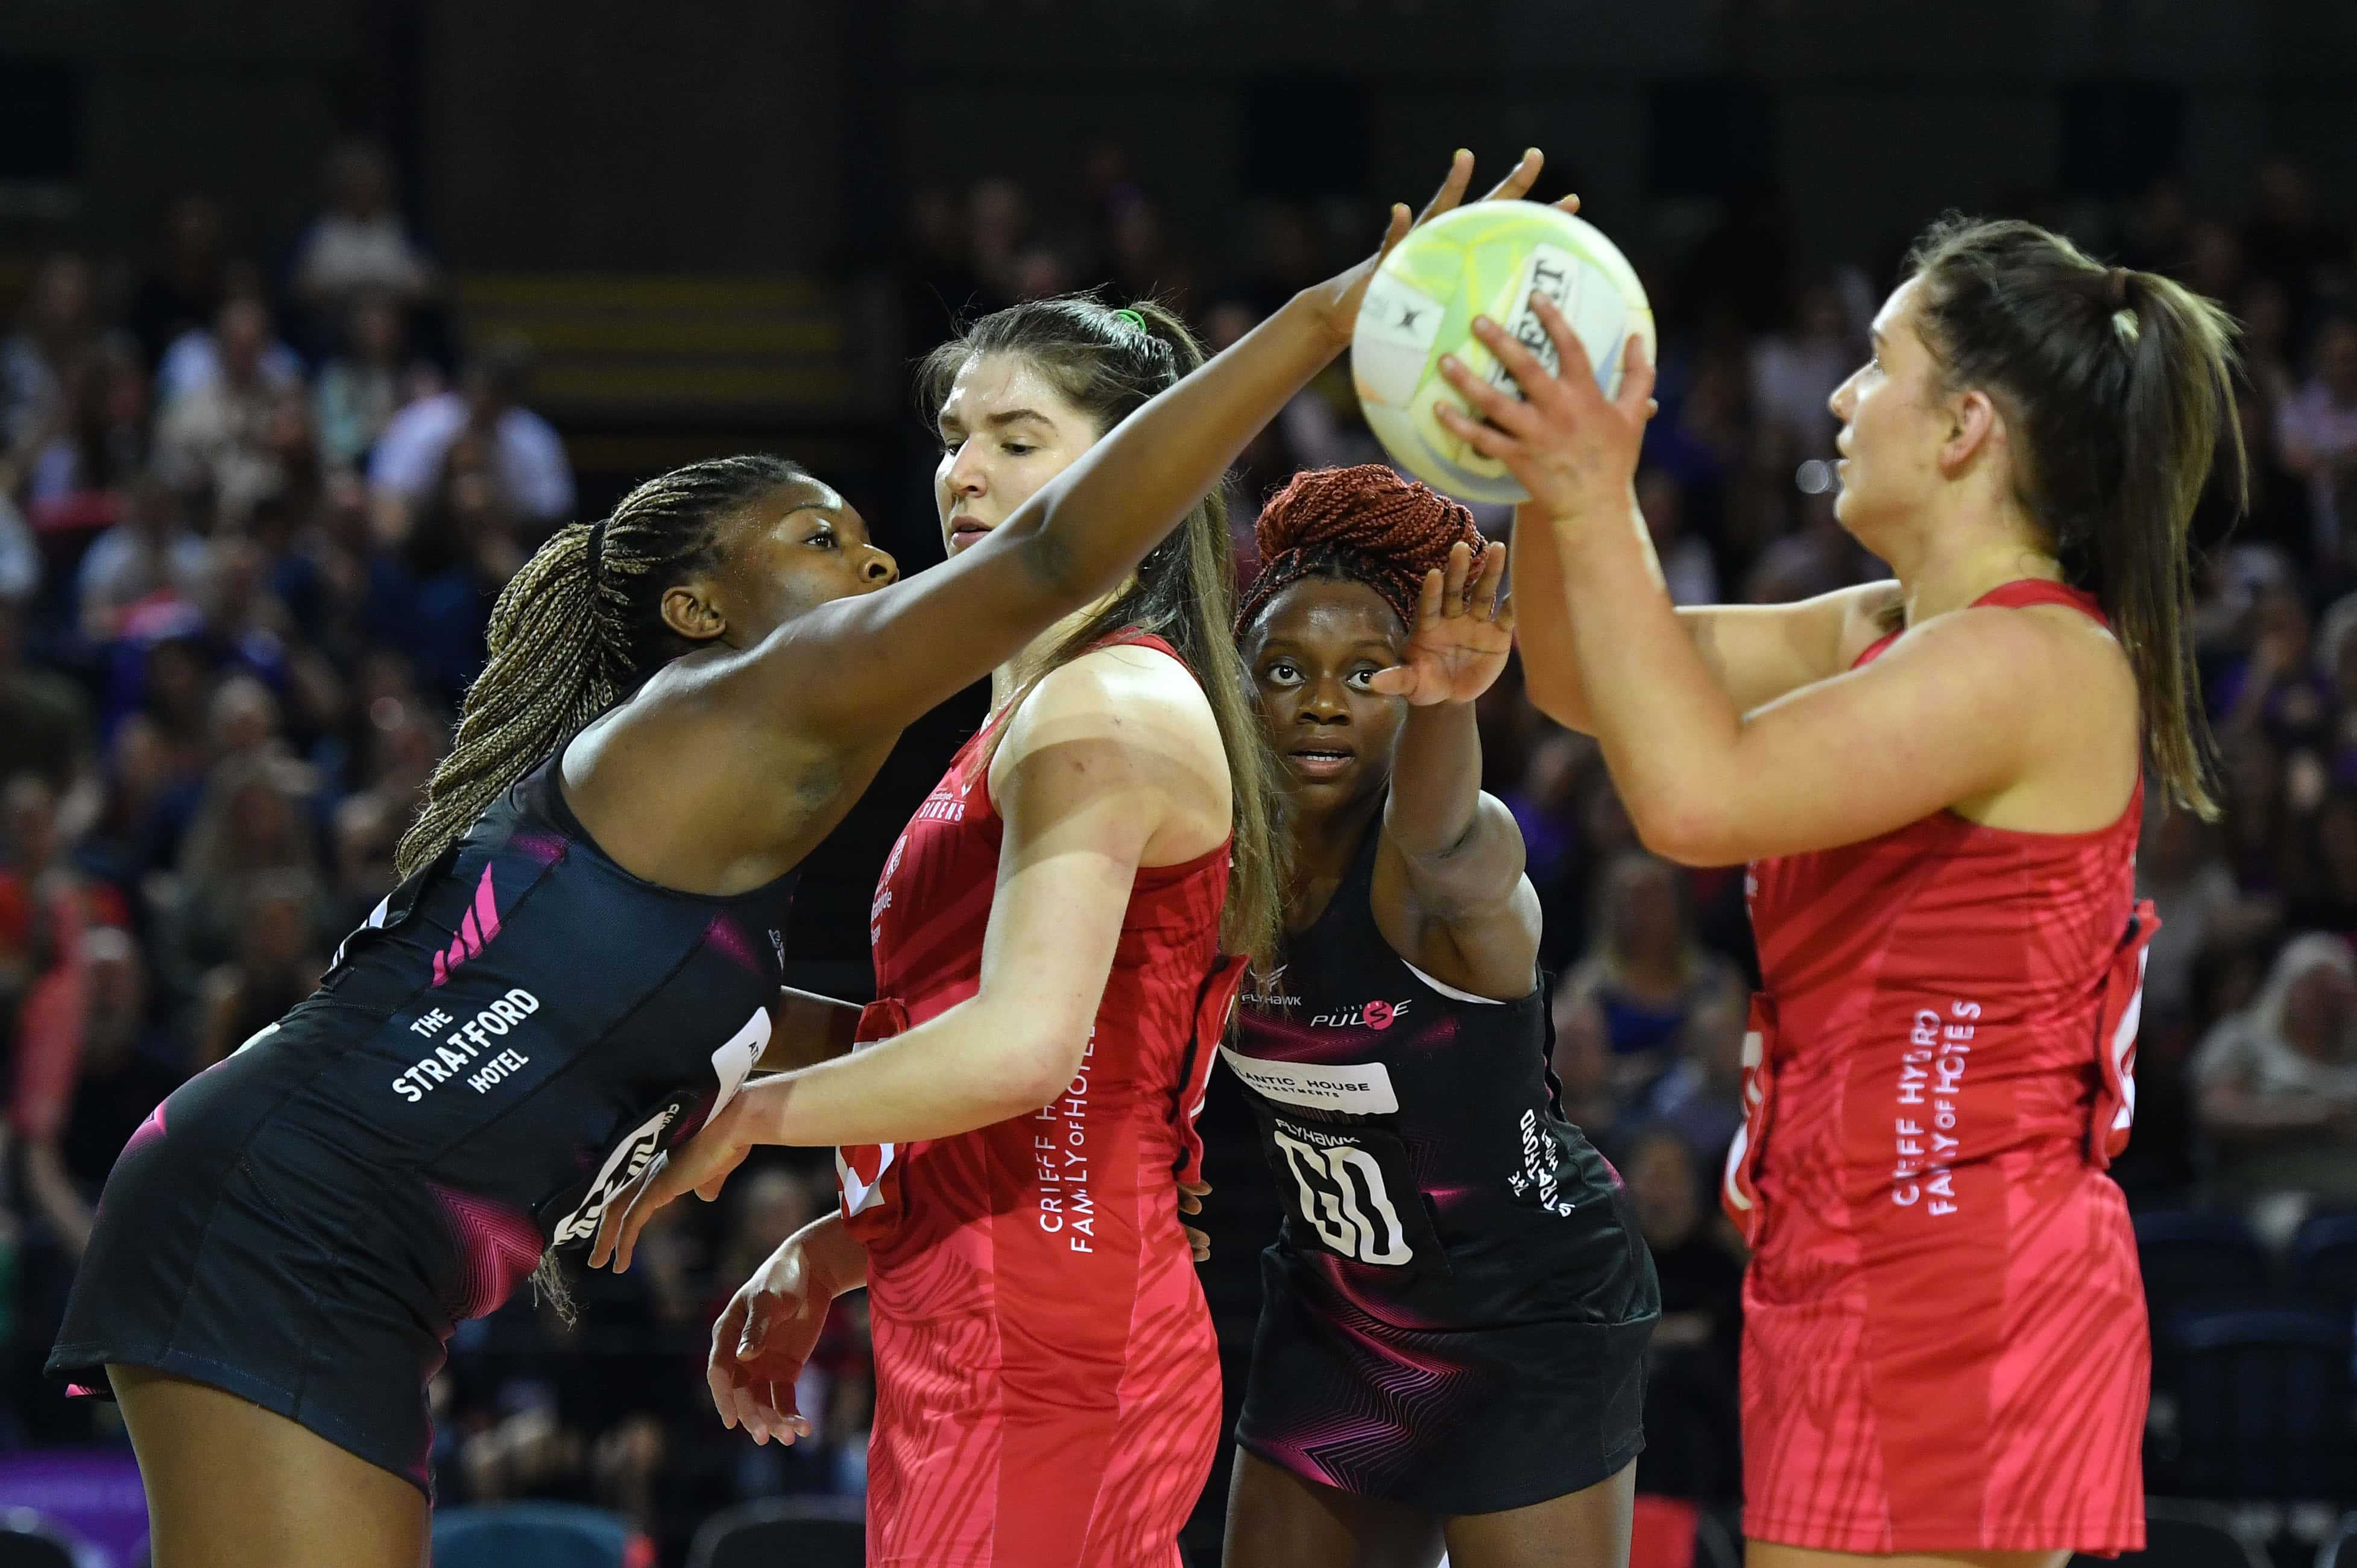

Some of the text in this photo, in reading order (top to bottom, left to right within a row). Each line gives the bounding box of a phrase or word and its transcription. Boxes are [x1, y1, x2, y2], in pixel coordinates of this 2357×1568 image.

[392, 989, 539, 1102] STRATFORD
[409, 1007, 453, 1038] THE
[1310, 999, 1412, 1029] PULSE
[1932, 1000, 1981, 1094] HOTES
[467, 1048, 529, 1094] HOTEL
[1233, 1065, 1371, 1092] LANTIC HOUSE
[1069, 1120, 1084, 1146] OF
[1934, 1099, 1956, 1130] OF
[1035, 1136, 1063, 1233] CRIEFF
[1274, 1130, 1413, 1265] GD
[1520, 1109, 1576, 1217] STRATFORD
[1064, 1149, 1094, 1253] FAMLY
